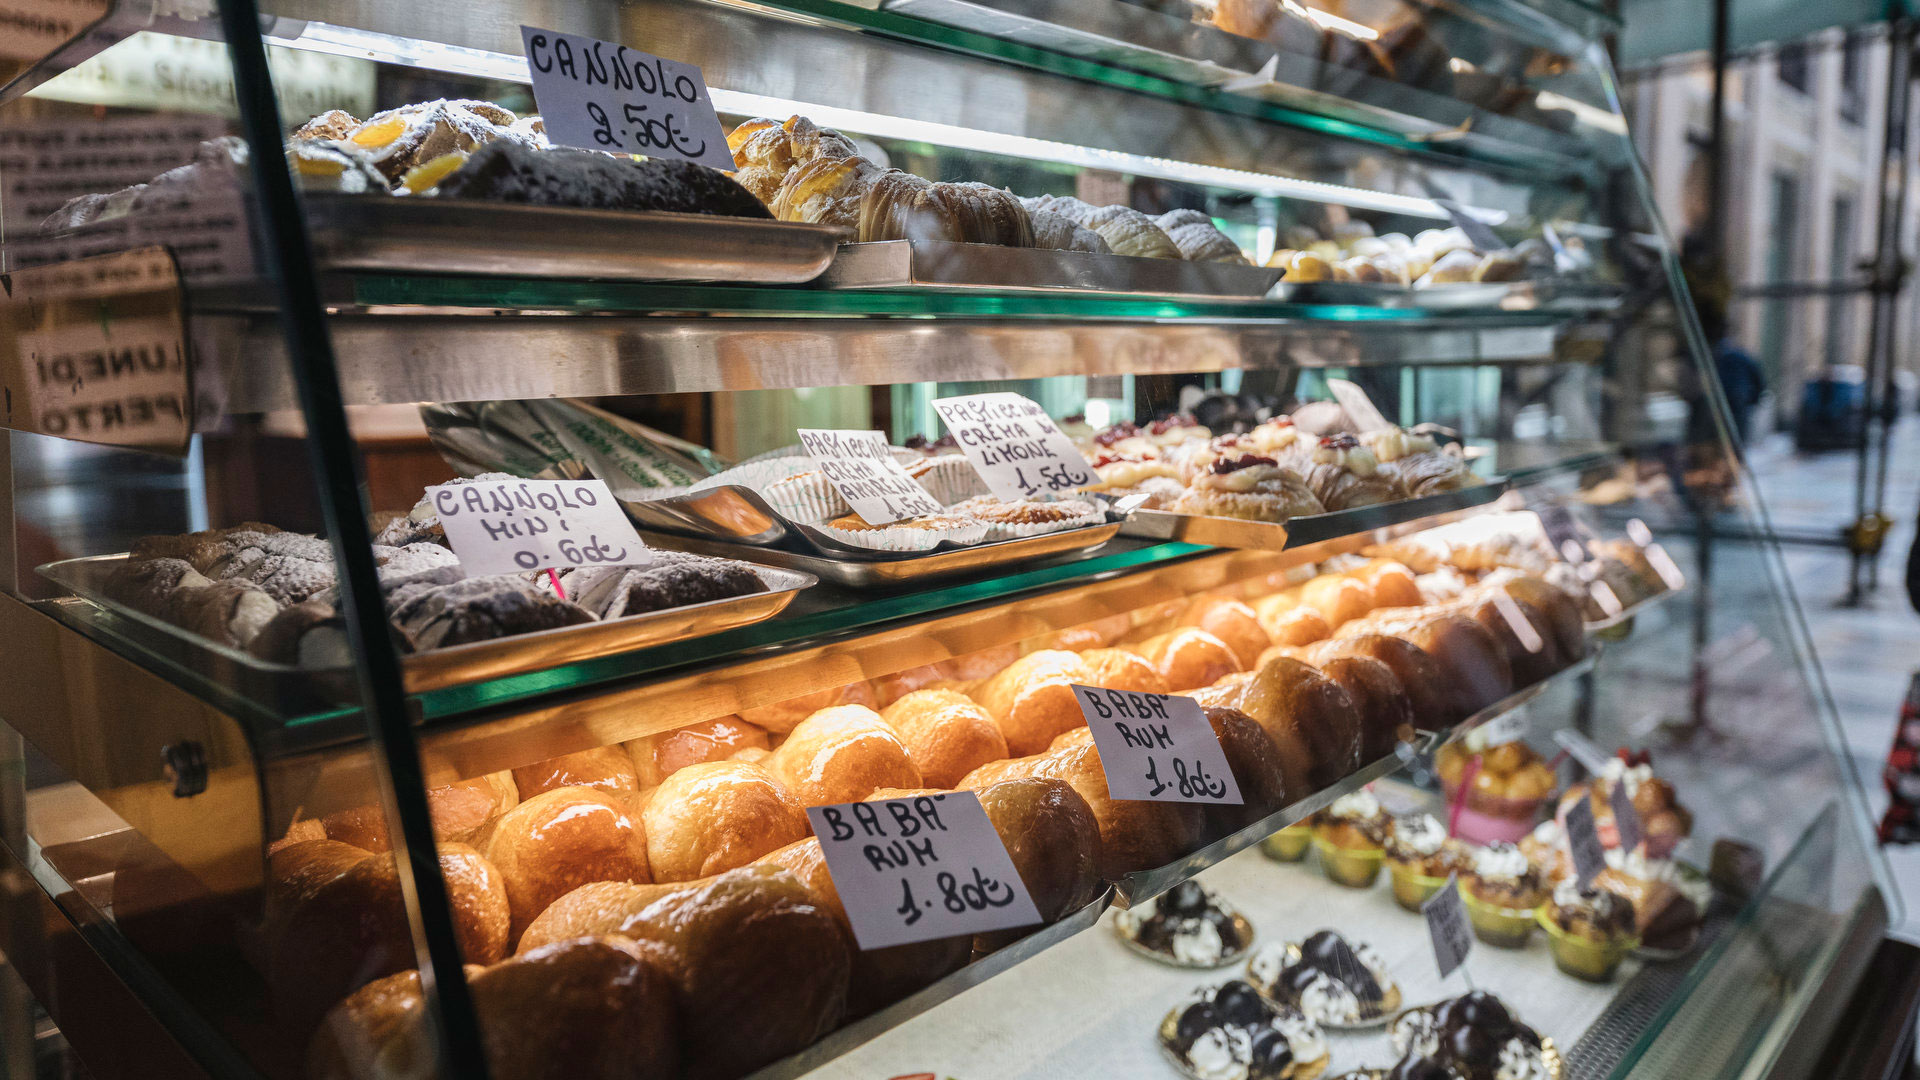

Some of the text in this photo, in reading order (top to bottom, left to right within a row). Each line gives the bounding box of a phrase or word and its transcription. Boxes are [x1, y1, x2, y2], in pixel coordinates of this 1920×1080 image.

[530, 34, 698, 103] CANNOLO
[960, 422, 1030, 446] CREMA
[821, 460, 876, 481] CREMA
[435, 483, 597, 517] CANNOLO
[1114, 721, 1175, 750] RUM
[863, 837, 939, 872] RUM
